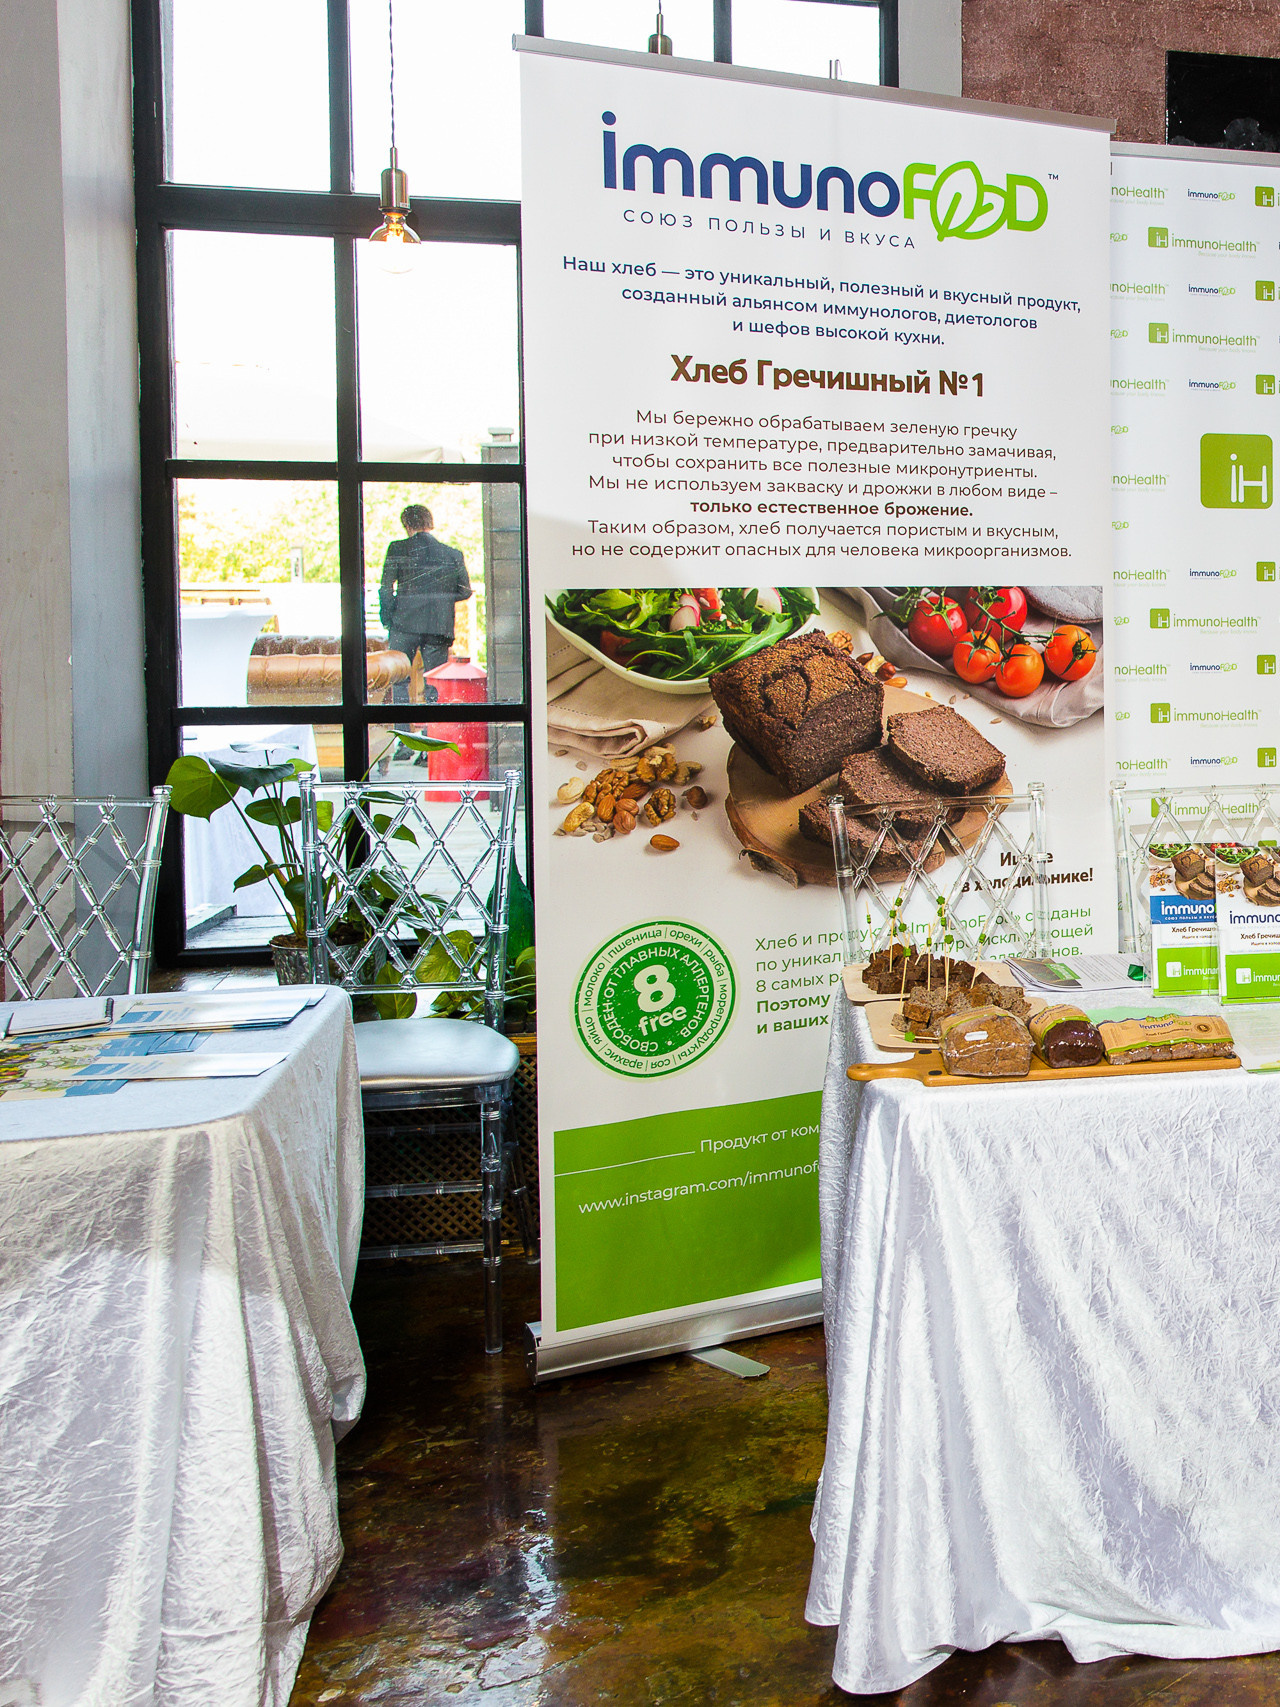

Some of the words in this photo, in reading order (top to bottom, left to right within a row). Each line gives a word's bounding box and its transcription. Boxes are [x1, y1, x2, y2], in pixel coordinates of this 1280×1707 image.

[624, 210, 692, 227] СОЮЗ
[709, 218, 804, 238] ПОЛЬЗЫ
[820, 229, 830, 241] И
[845, 231, 914, 248] ВКУСА
[564, 256, 605, 272] Наш
[612, 263, 656, 276] хлеб
[685, 270, 714, 281] это
[718, 272, 834, 295] уникальный,
[840, 282, 923, 298] полезный
[930, 289, 938, 299] и
[944, 291, 1012, 305] вкусный
[1018, 297, 1080, 313] продукт,
[622, 289, 726, 306] созданный
[733, 297, 817, 312] альянсом
[824, 304, 940, 324] иммунологов,
[945, 314, 1037, 329] диетологов
[733, 321, 742, 331] и
[750, 321, 809, 337] шефов
[816, 327, 888, 341] высокой
[895, 332, 944, 345] кухни.
[671, 355, 747, 385] Хлеб
[758, 360, 930, 394] Гречишный
[939, 370, 982, 397] №1
[637, 410, 666, 423] Мы
[674, 411, 753, 428] бережно
[759, 415, 884, 432] обрабатываем
[891, 423, 958, 437] зеленую
[964, 427, 1017, 440] гречку
[590, 433, 624, 447] при
[630, 432, 699, 447] низкой
[704, 437, 822, 453] температуре,
[828, 442, 964, 456] предварительно
[969, 447, 1055, 460] замачивая,
[613, 454, 668, 468] чтобы
[676, 458, 767, 472] сохранить
[774, 461, 802, 471] все
[809, 462, 890, 473] полезные
[897, 465, 1037, 479] микронутриенты.
[590, 475, 619, 489] Мы
[627, 479, 648, 489] не
[655, 480, 761, 494] используем
[767, 482, 843, 496] закваску
[849, 484, 857, 493] и
[863, 485, 931, 497] дрожжи
[938, 486, 945, 495] в
[949, 484, 1002, 496] любом
[1008, 488, 1045, 499] виде
[690, 502, 752, 512] только
[758, 503, 879, 514] естественное
[885, 502, 972, 518] брожение.
[588, 520, 645, 533] Таким
[653, 520, 734, 537] образом,
[739, 521, 780, 534] хлеб
[787, 525, 880, 538] получается
[888, 526, 967, 538] пористым
[973, 527, 981, 536] и
[987, 528, 1058, 540] вкусным,
[573, 545, 595, 555] но
[602, 546, 623, 555] не
[630, 546, 720, 559] содержит
[726, 546, 800, 555] опасных
[806, 546, 835, 557] для
[841, 546, 918, 556] человека
[925, 547, 1071, 559] микроорганизмов.
[756, 933, 797, 951] Хлеб
[803, 936, 812, 945] и
[757, 961, 777, 971] по
[634, 964, 676, 1013] 8
[756, 980, 766, 992] 8
[772, 975, 823, 990] самых
[757, 995, 830, 1013] Поэтому
[638, 1006, 687, 1036] free
[757, 1024, 767, 1034] и
[774, 1015, 828, 1032] ваших
[701, 1133, 768, 1153] Продукт
[771, 1130, 787, 1141] от
